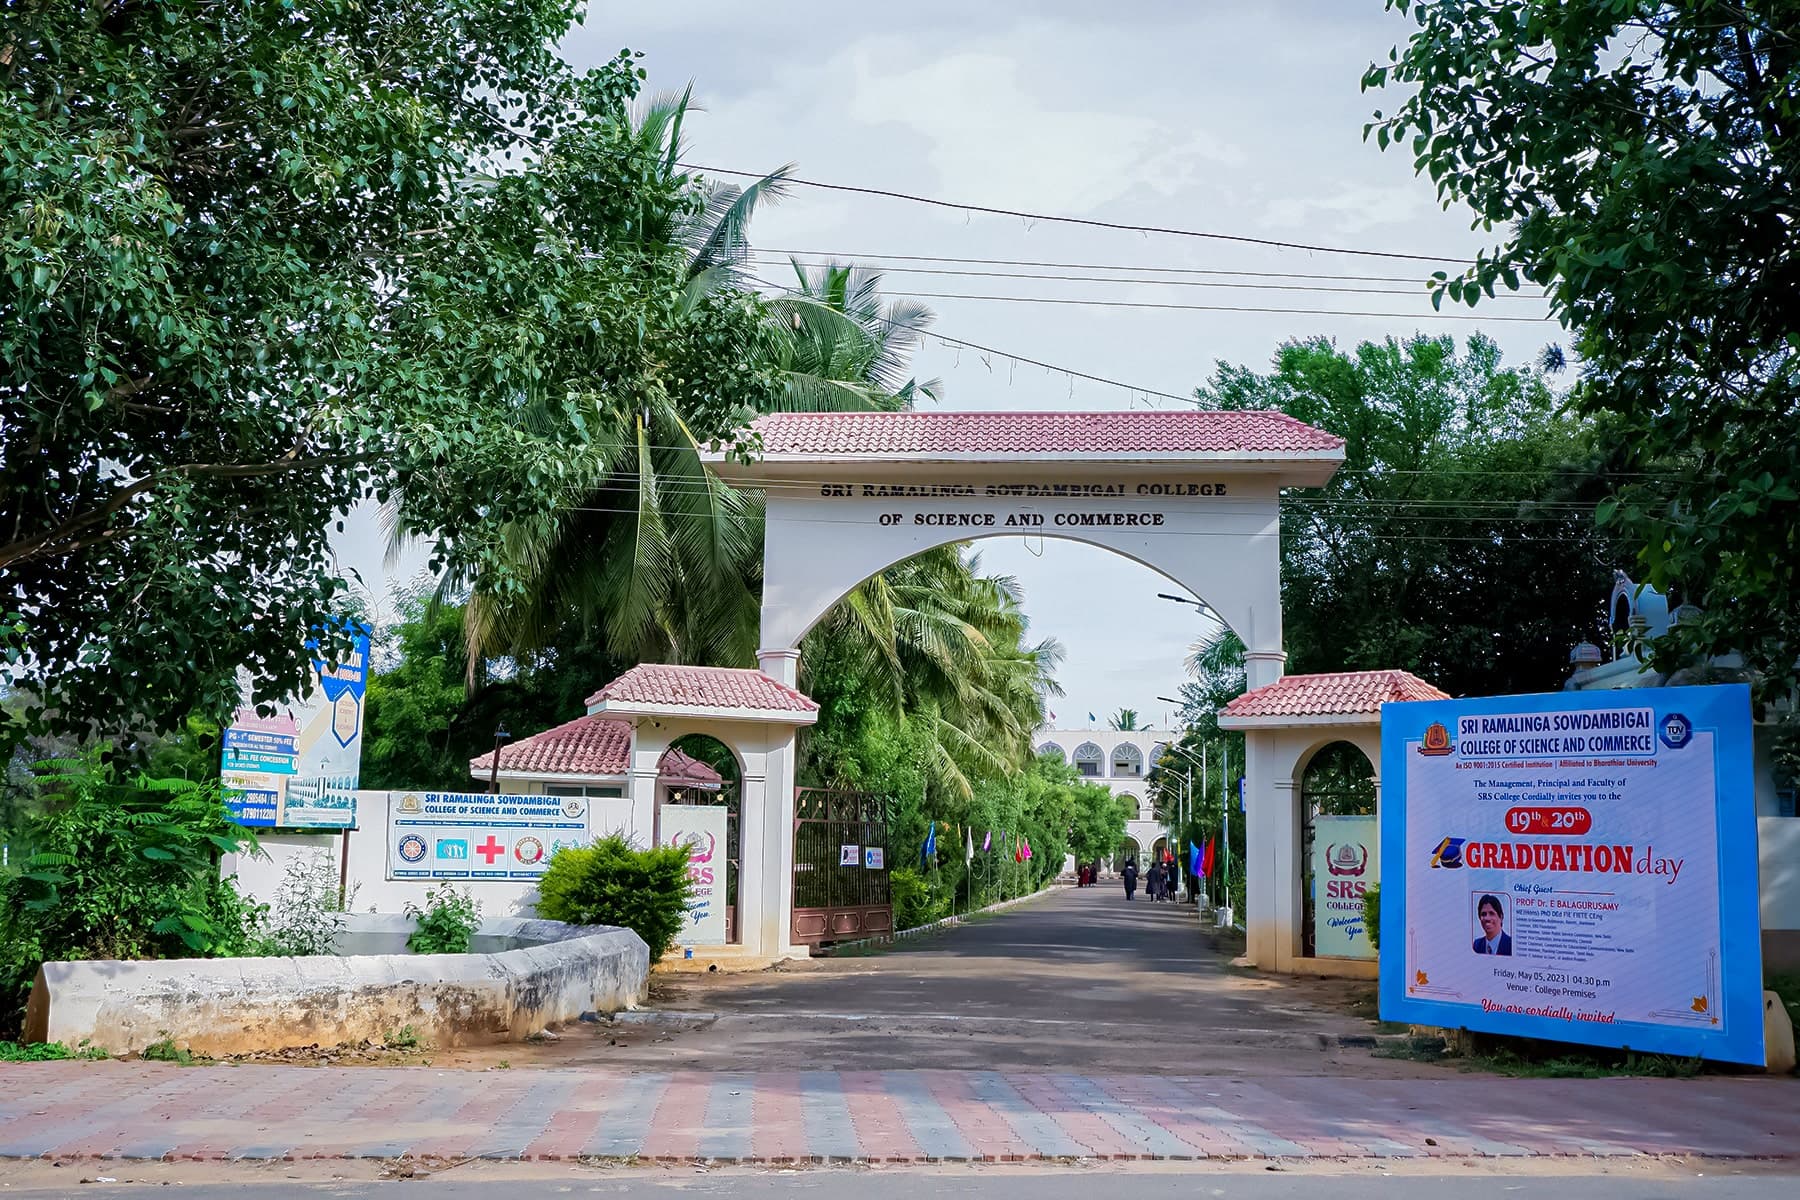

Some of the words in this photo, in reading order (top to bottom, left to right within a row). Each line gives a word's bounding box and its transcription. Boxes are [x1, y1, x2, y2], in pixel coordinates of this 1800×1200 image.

[820, 484, 853, 497] SRI
[862, 484, 976, 497] RAMALINGA
[985, 484, 1126, 498] SOWDAMBIGAI
[1136, 483, 1227, 497] COLLEGE
[878, 513, 903, 526] OF
[914, 513, 996, 526] SCIENCE
[1004, 513, 1044, 526] AND
[1054, 513, 1165, 526] COMMERCE
[1461, 719, 1478, 735] SRI
[1482, 715, 1551, 734] RAMALINGA
[1553, 711, 1650, 731] SOWDAMBIGAI
[1460, 739, 1501, 755] COLLEGE
[1503, 739, 1517, 754] OF
[1520, 737, 1560, 754] SCIENCE
[1562, 736, 1585, 753] AND
[1588, 735, 1651, 752] COMMERCE
[1463, 761, 1472, 769] ISO
[1473, 761, 1501, 769] 9001:2015
[1501, 760, 1524, 769] Certified
[1525, 760, 1553, 769] Institution
[1586, 759, 1593, 767] to
[1626, 757, 1658, 768] University
[1473, 779, 1487, 788] The
[1488, 779, 1536, 789] Management,
[1537, 779, 1570, 789] Principal
[1571, 778, 1586, 787] and
[1587, 778, 1616, 788] Faculty
[1617, 777, 1627, 787] of
[425, 793, 440, 803] SRI
[442, 793, 495, 805] RAMALINGA
[497, 795, 561, 806] SOWDAMBIGAI
[1478, 793, 1493, 801] SRS
[1493, 793, 1521, 802] College
[1521, 792, 1555, 803] Cordially
[1557, 792, 1582, 801] invites
[1583, 794, 1597, 802] you
[1598, 793, 1607, 801] to
[1608, 791, 1621, 801] the
[425, 805, 456, 814] COLLEGE
[458, 806, 468, 814] OF
[470, 806, 499, 815] SCIENCE
[501, 807, 518, 816] AND
[519, 808, 560, 816] COMMERCE
[1511, 811, 1542, 832] 19th
[1551, 811, 1585, 828] 20th
[1465, 842, 1633, 874] GRADUATION
[1636, 846, 1684, 885] day
[1326, 880, 1367, 899] SRS
[1513, 883, 1532, 893] Chief
[1533, 884, 1553, 895] Guest
[1516, 898, 1535, 907] PROF
[1537, 899, 1548, 908] Dr.
[1550, 899, 1555, 908] E
[1557, 899, 1620, 911] BALAGURUSAMY
[1493, 968, 1517, 980] Friday,
[1517, 971, 1533, 981] May
[1533, 972, 1546, 982] 05,
[1546, 973, 1566, 983] 2023
[1572, 975, 1595, 986] 04.30
[1595, 978, 1611, 987] p.m
[1506, 982, 1529, 992] Venue
[1534, 984, 1561, 996] College
[1562, 987, 1597, 999] Premises
[1481, 998, 1503, 1013] You
[1506, 1004, 1522, 1014] are
[1525, 1004, 1574, 1022] cordially
